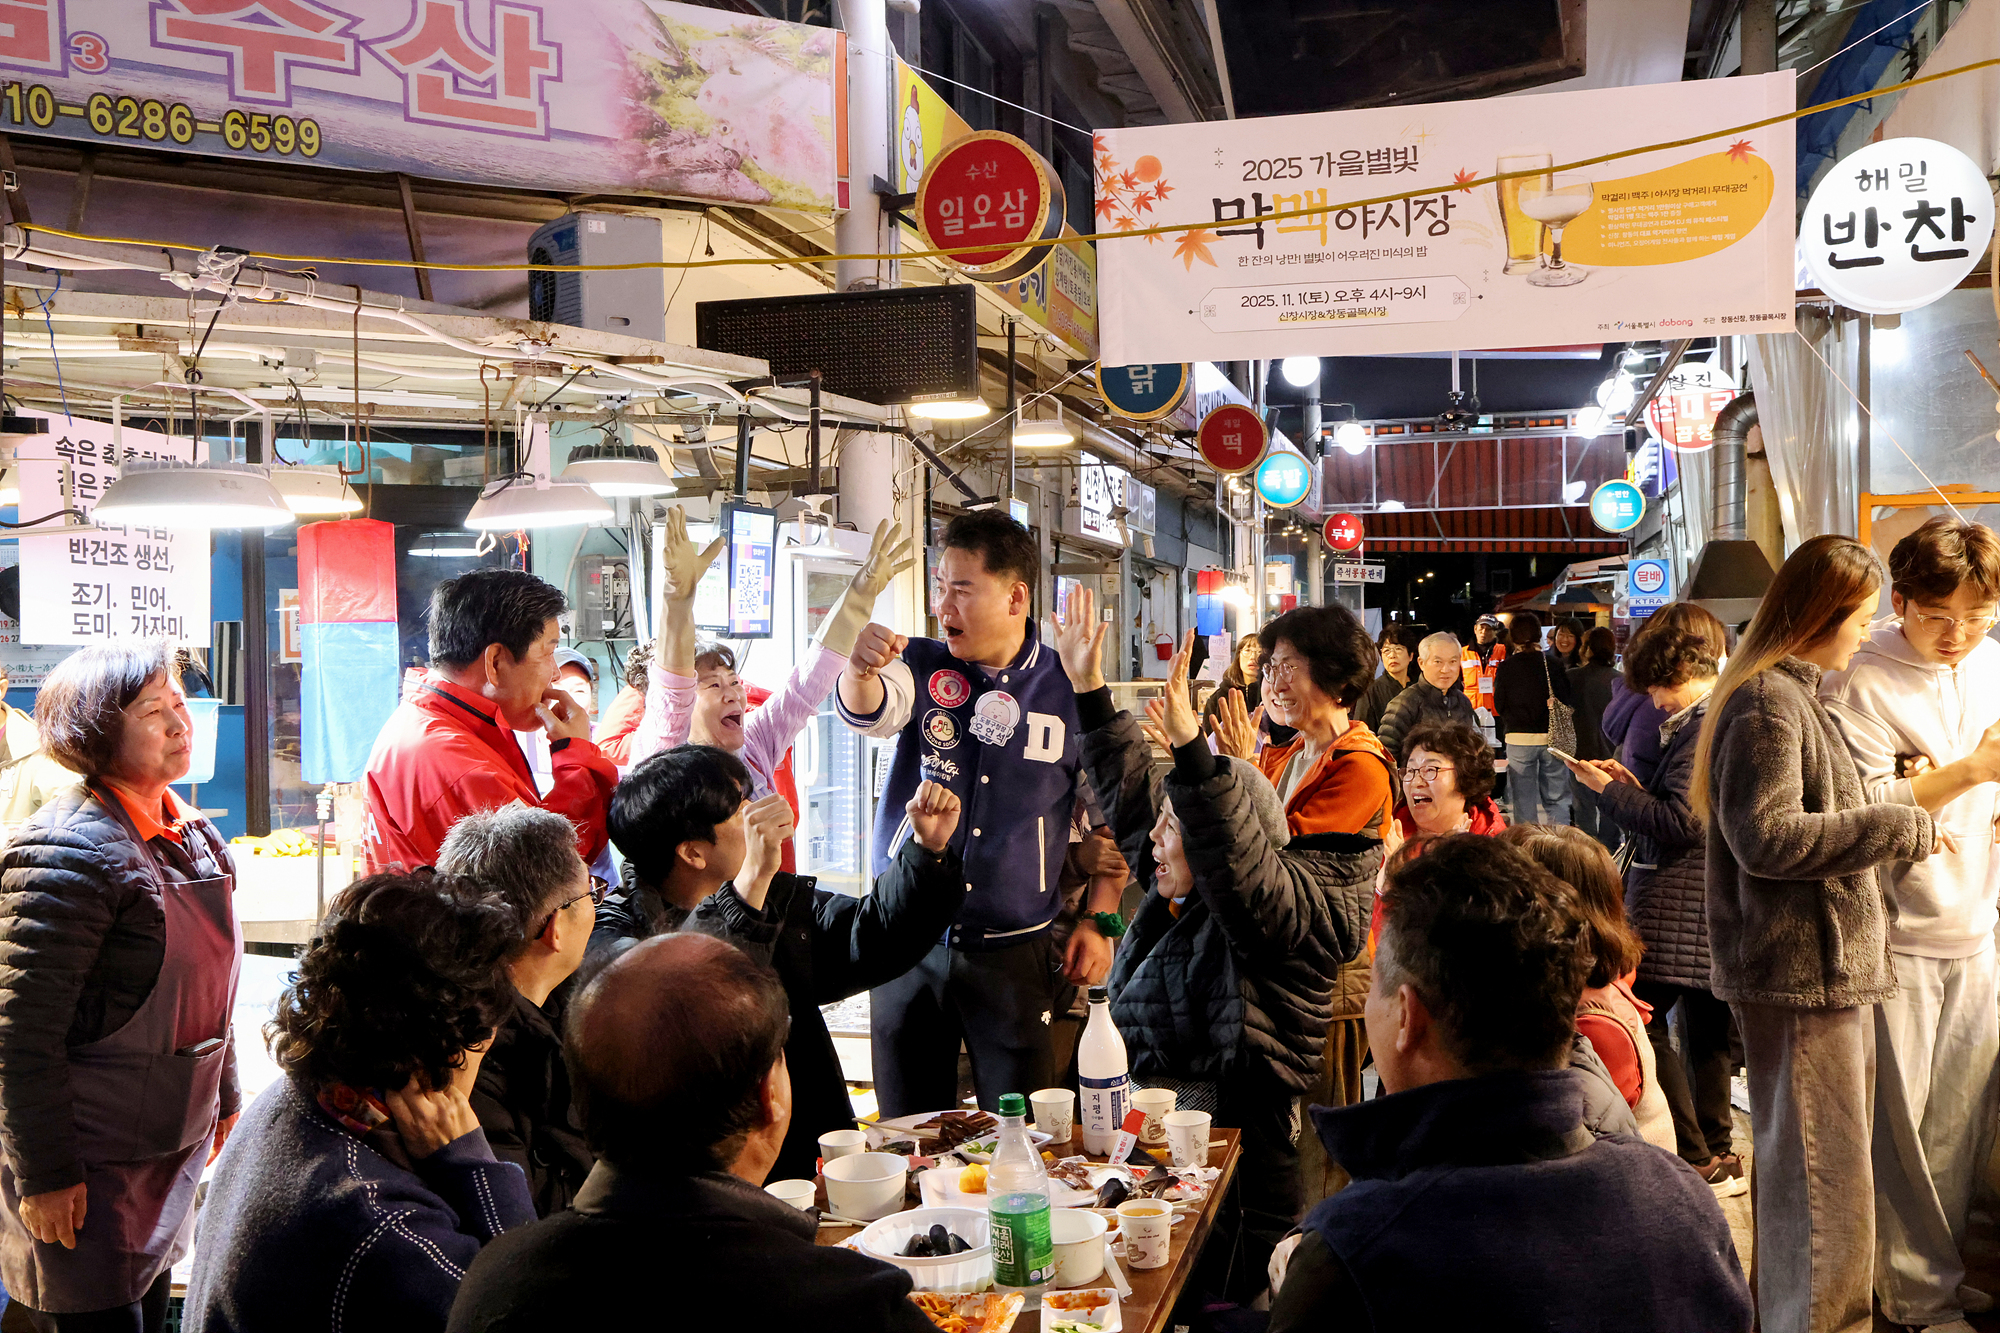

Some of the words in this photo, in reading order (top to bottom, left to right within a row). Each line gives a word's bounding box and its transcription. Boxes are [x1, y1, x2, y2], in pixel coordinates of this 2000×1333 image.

[152, 0, 561, 138] 수산
[0, 79, 323, 159] 10-6286-6599
[965, 161, 998, 181] 수산
[1242, 157, 1303, 182] 2025
[1309, 145, 1419, 178] 가을별빛
[1854, 160, 1928, 193] 해밀
[1601, 192, 1627, 202] 막걸리
[1632, 191, 1649, 200] 맥주
[1655, 189, 1680, 198] 야시장
[1682, 186, 1707, 196] 먹거리
[1712, 183, 1748, 193] 무대공연
[939, 188, 1029, 237] 일오삼
[1823, 197, 1977, 270] 반찬
[1237, 255, 1249, 267] 한
[1251, 254, 1273, 266] 잔의
[1276, 252, 1301, 265] 낭만!
[1303, 251, 1335, 264] 별빛이
[1337, 249, 1381, 262] 어우러진
[1382, 247, 1414, 259] 미식의
[1416, 246, 1428, 258] 밤
[1241, 295, 1279, 308] 2025.
[1282, 293, 1295, 306] 11.
[1299, 290, 1330, 305] 1(토)
[1333, 288, 1366, 303] 오후
[1369, 285, 1427, 301] 4시~9시
[1279, 306, 1387, 322] 신창시장&창동골목시장
[1624, 321, 1656, 330] 서울특별시
[1659, 318, 1694, 327] dobong
[1703, 317, 1716, 325] 주관
[1721, 314, 1748, 323] 창동신창,
[1749, 312, 1787, 322] 창동골목시장
[1127, 364, 1156, 395] 닭
[1224, 418, 1241, 429] 제일
[55, 436, 97, 467] 속은
[1222, 433, 1242, 455] 떡
[1263, 468, 1303, 489] 족발
[1601, 502, 1634, 518] 마트
[1331, 528, 1356, 541] 두부
[69, 538, 129, 566] 반건조
[134, 543, 174, 573] 생선,
[1637, 570, 1661, 582] 담배
[71, 582, 117, 609] 조기.
[131, 585, 171, 612] 민어.
[72, 612, 118, 638] 도미.
[131, 615, 188, 640] 가자미.
[980, 716, 1007, 733] 도봉구청장
[925, 728, 942, 746] DOBONG
[1023, 711, 1066, 764] D
[1092, 1093, 1101, 1115] 지평
[991, 1238, 1010, 1250] 미래
